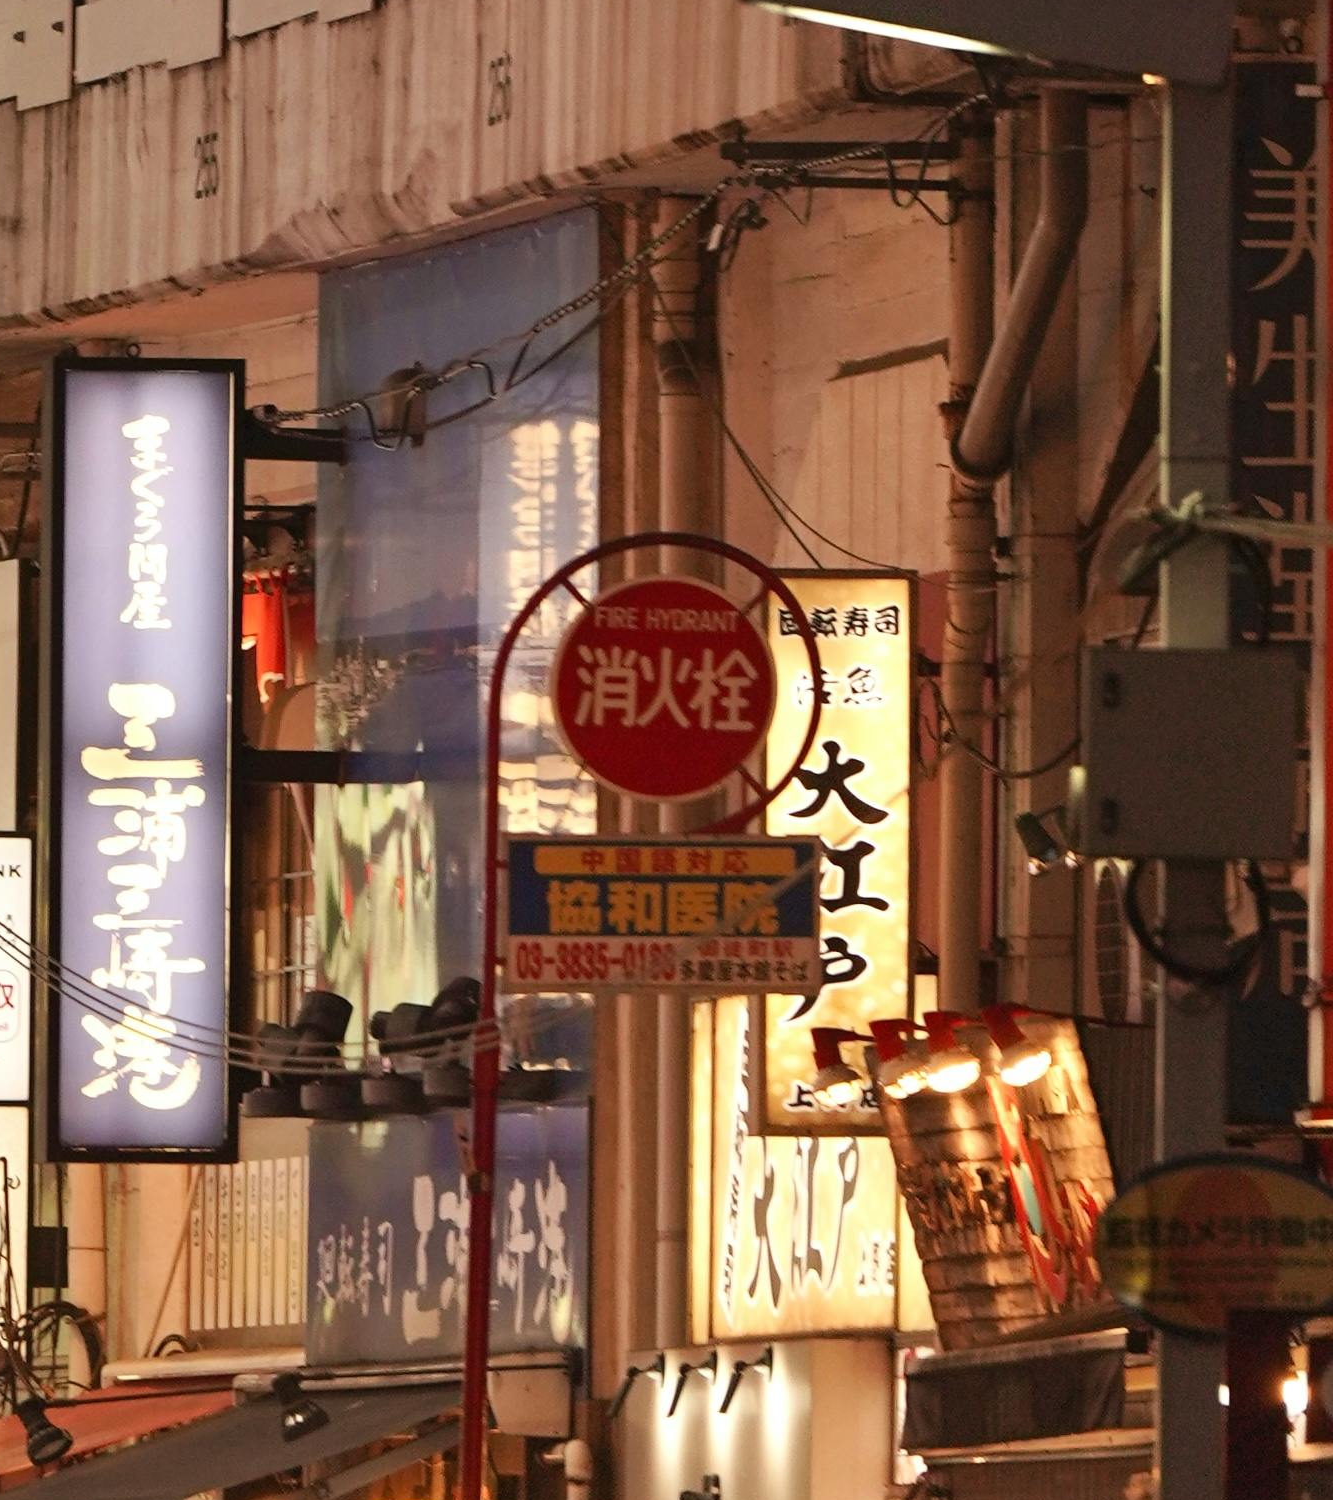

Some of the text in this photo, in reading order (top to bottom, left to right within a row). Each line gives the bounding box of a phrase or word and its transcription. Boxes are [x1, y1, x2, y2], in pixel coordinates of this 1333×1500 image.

[594, 606, 742, 633] FIRE HYDRANT
[574, 645, 759, 732] 消火栓
[546, 879, 780, 935] 協和医院
